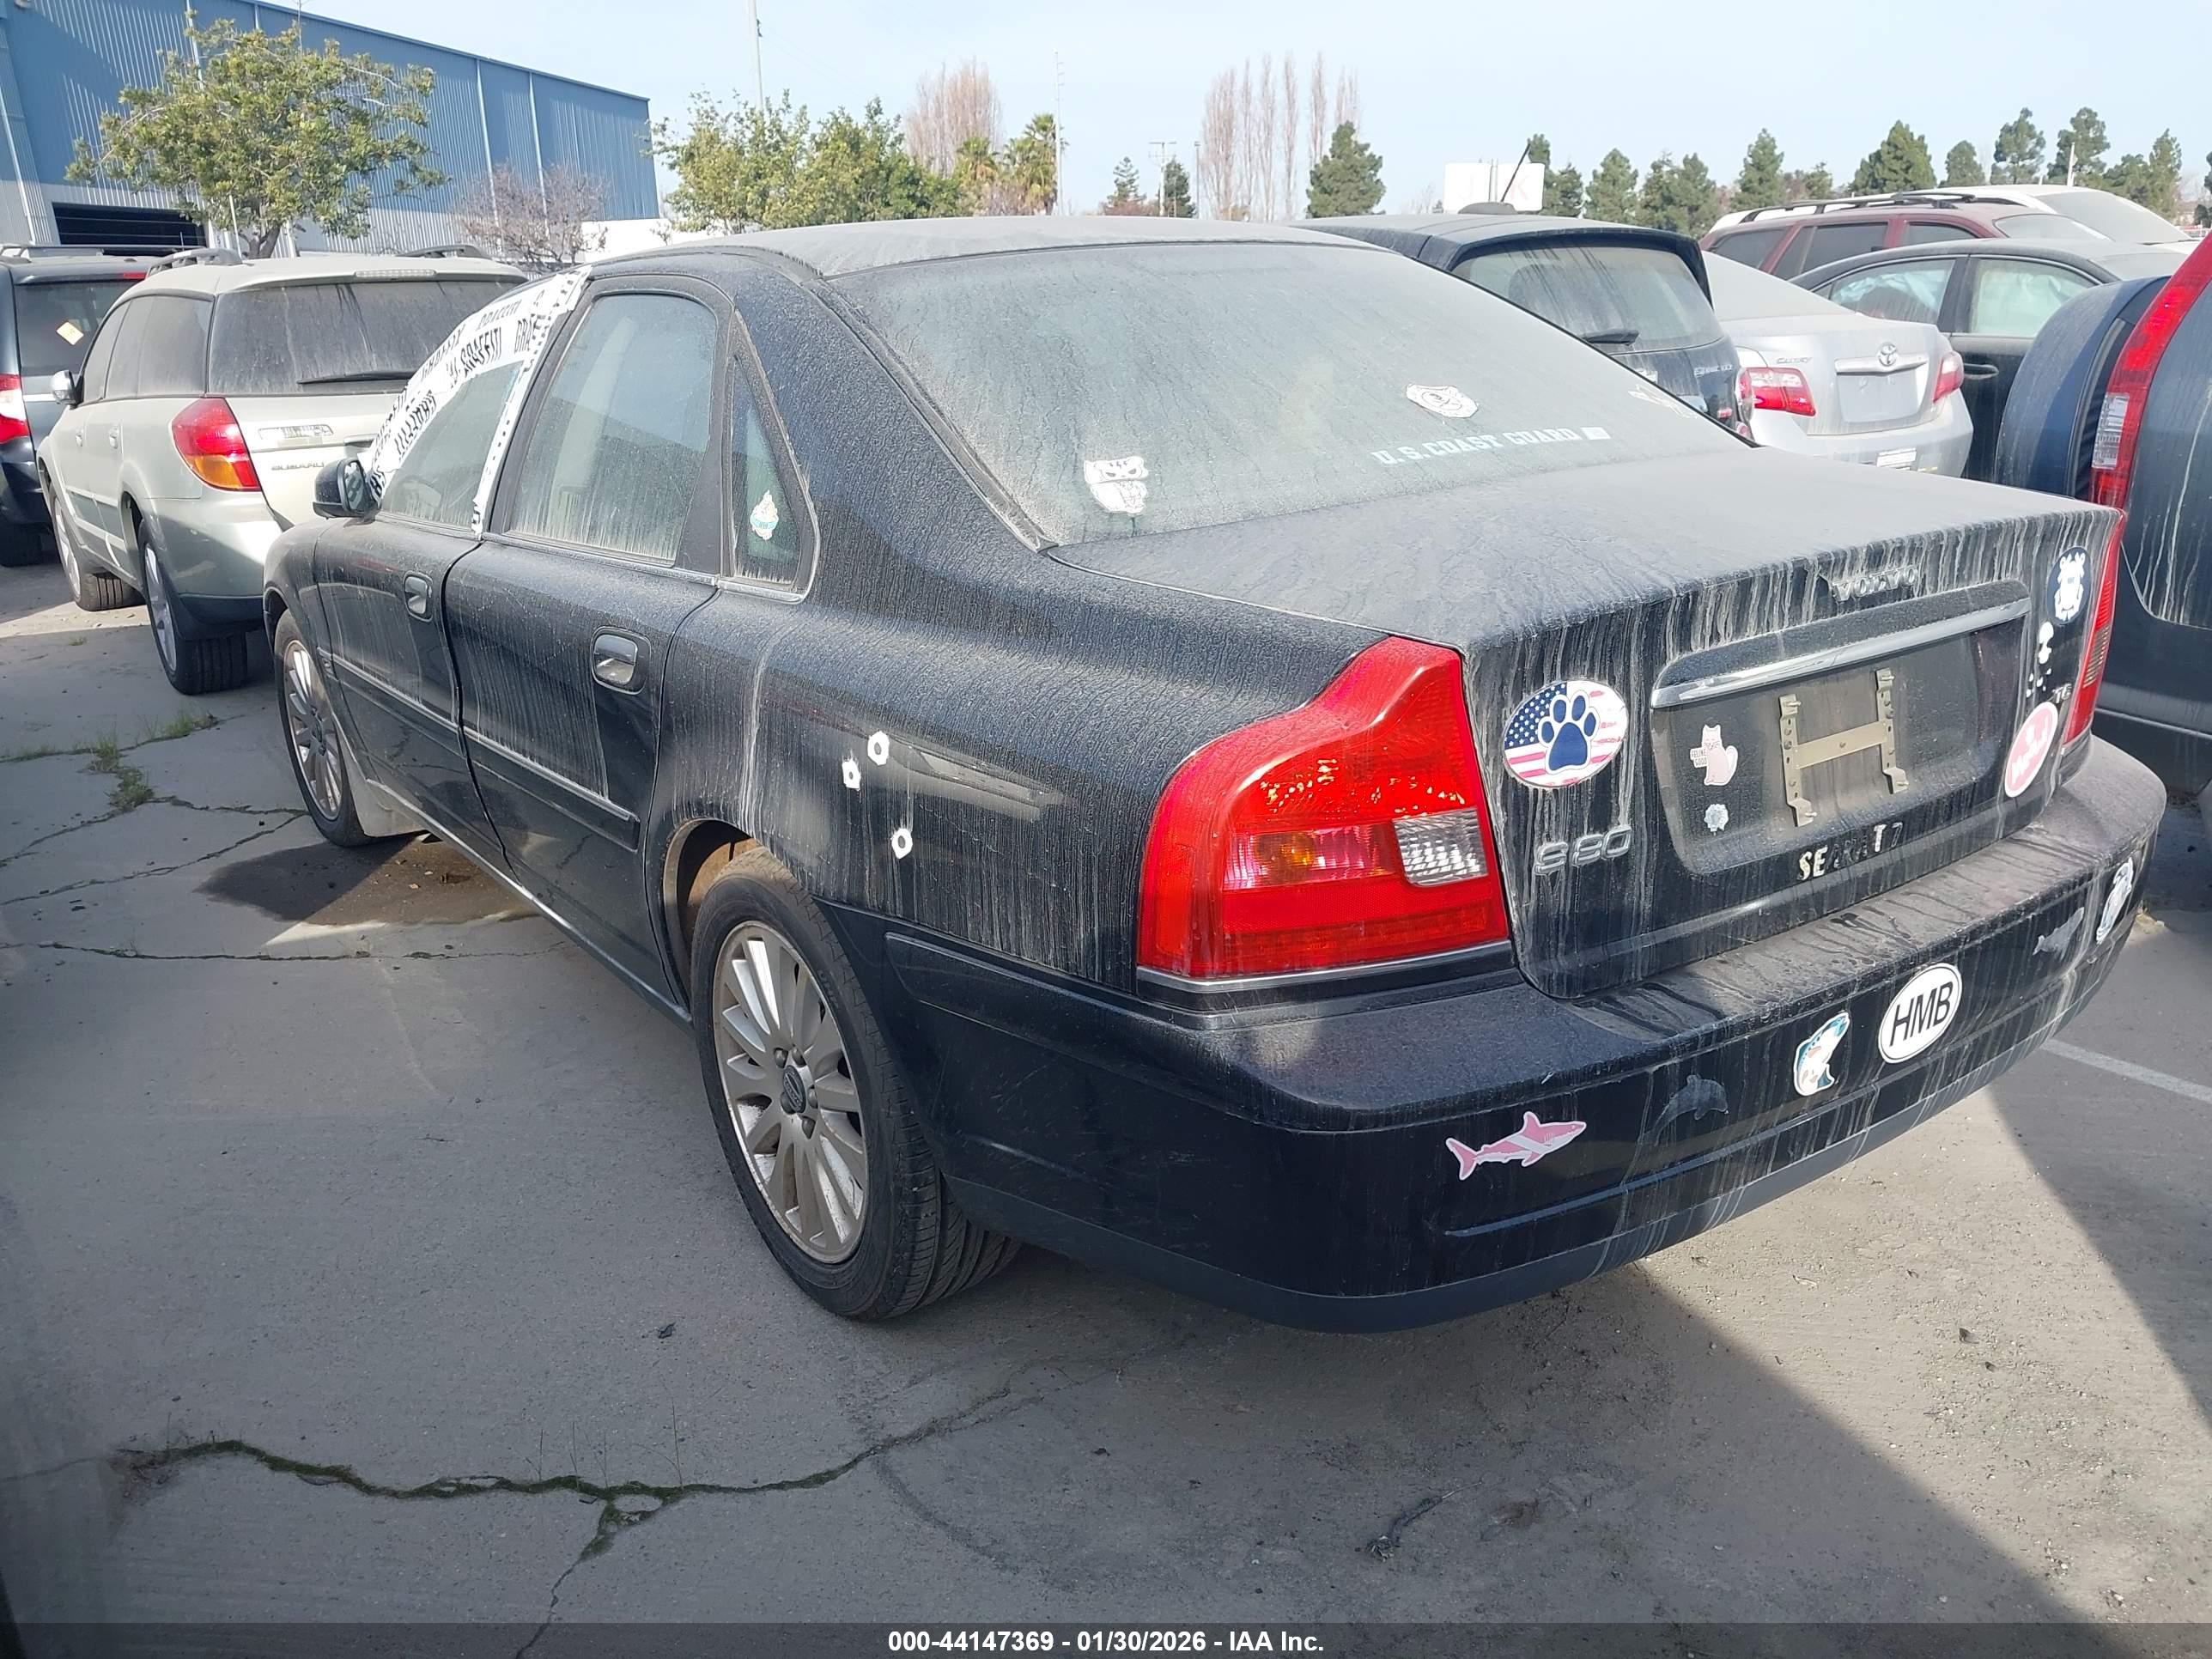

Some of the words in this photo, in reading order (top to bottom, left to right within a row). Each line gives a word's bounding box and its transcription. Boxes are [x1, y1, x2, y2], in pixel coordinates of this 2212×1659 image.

[1422, 434, 1503, 457] COAST
[1503, 428, 1583, 445] GUARD
[1832, 565, 1917, 602] VOLVO
[1534, 825, 1632, 876] S80
[1889, 981, 1954, 1048] HMB
